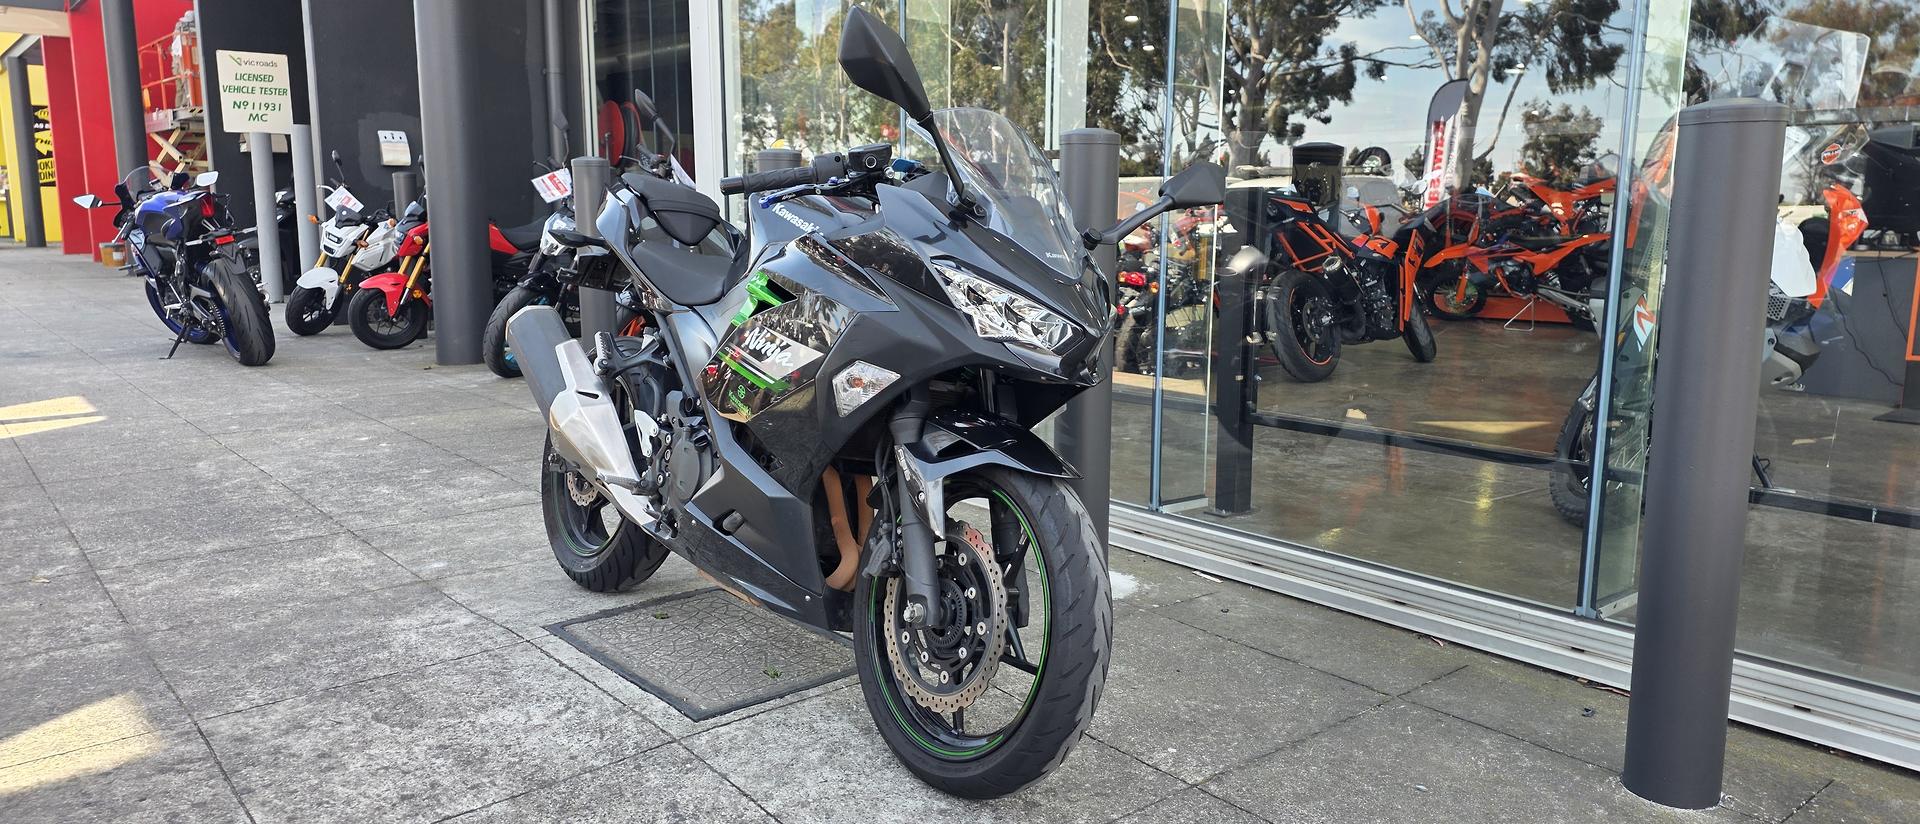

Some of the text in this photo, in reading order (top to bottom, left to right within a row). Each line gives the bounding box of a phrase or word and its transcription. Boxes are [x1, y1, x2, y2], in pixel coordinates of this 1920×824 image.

[243, 59, 278, 68] vicroads
[234, 72, 274, 82] LICENSED
[222, 84, 288, 96] VEHICLE TESTER
[248, 113, 269, 122] MC
[741, 326, 794, 368] Ninja
